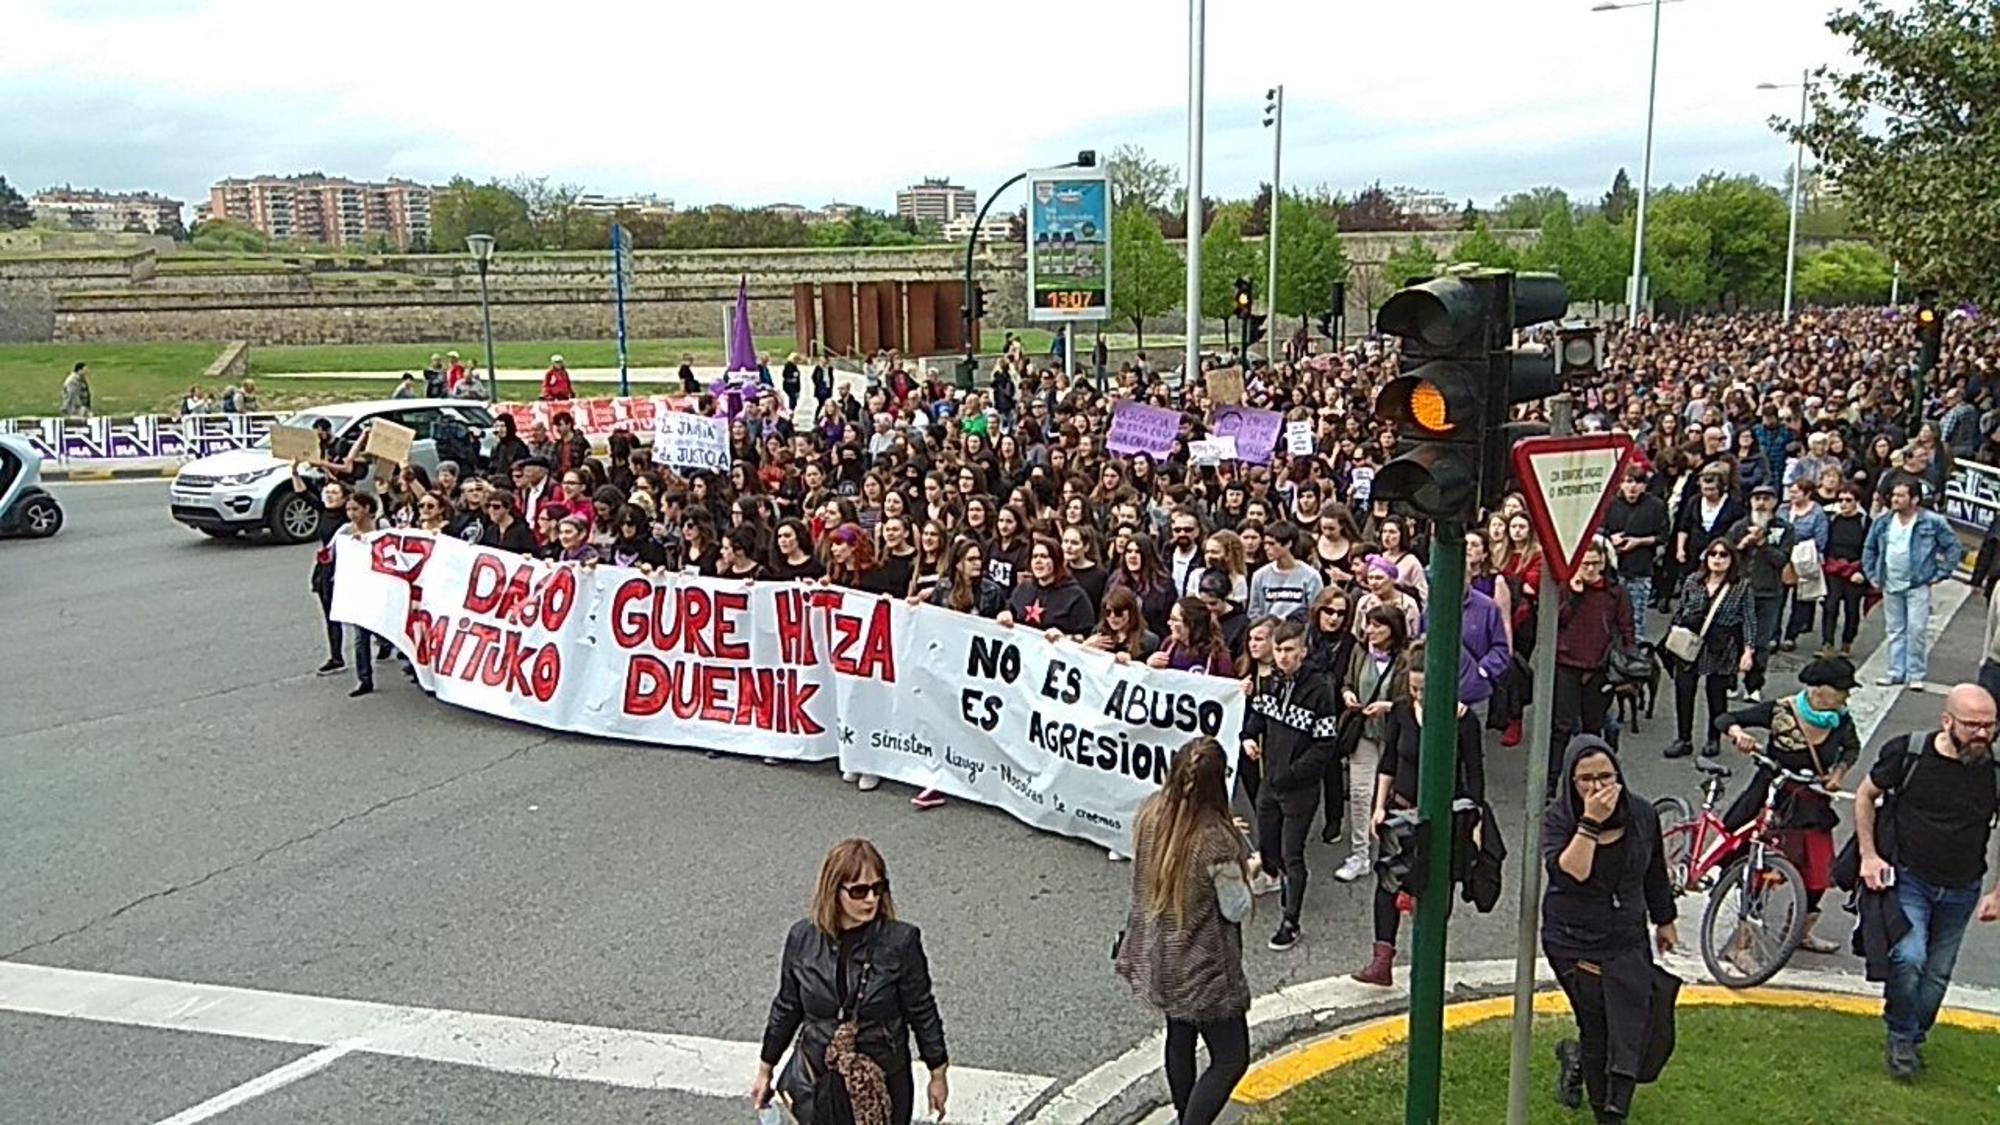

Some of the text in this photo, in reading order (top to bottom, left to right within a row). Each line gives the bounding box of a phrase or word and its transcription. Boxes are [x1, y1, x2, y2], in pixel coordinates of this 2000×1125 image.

[612, 577, 750, 660] GURE
[961, 688, 1003, 731] ES
[967, 636, 1223, 737] NO ES ABUSO
[871, 729, 933, 757] sinisten
[1053, 793, 1066, 812] te
